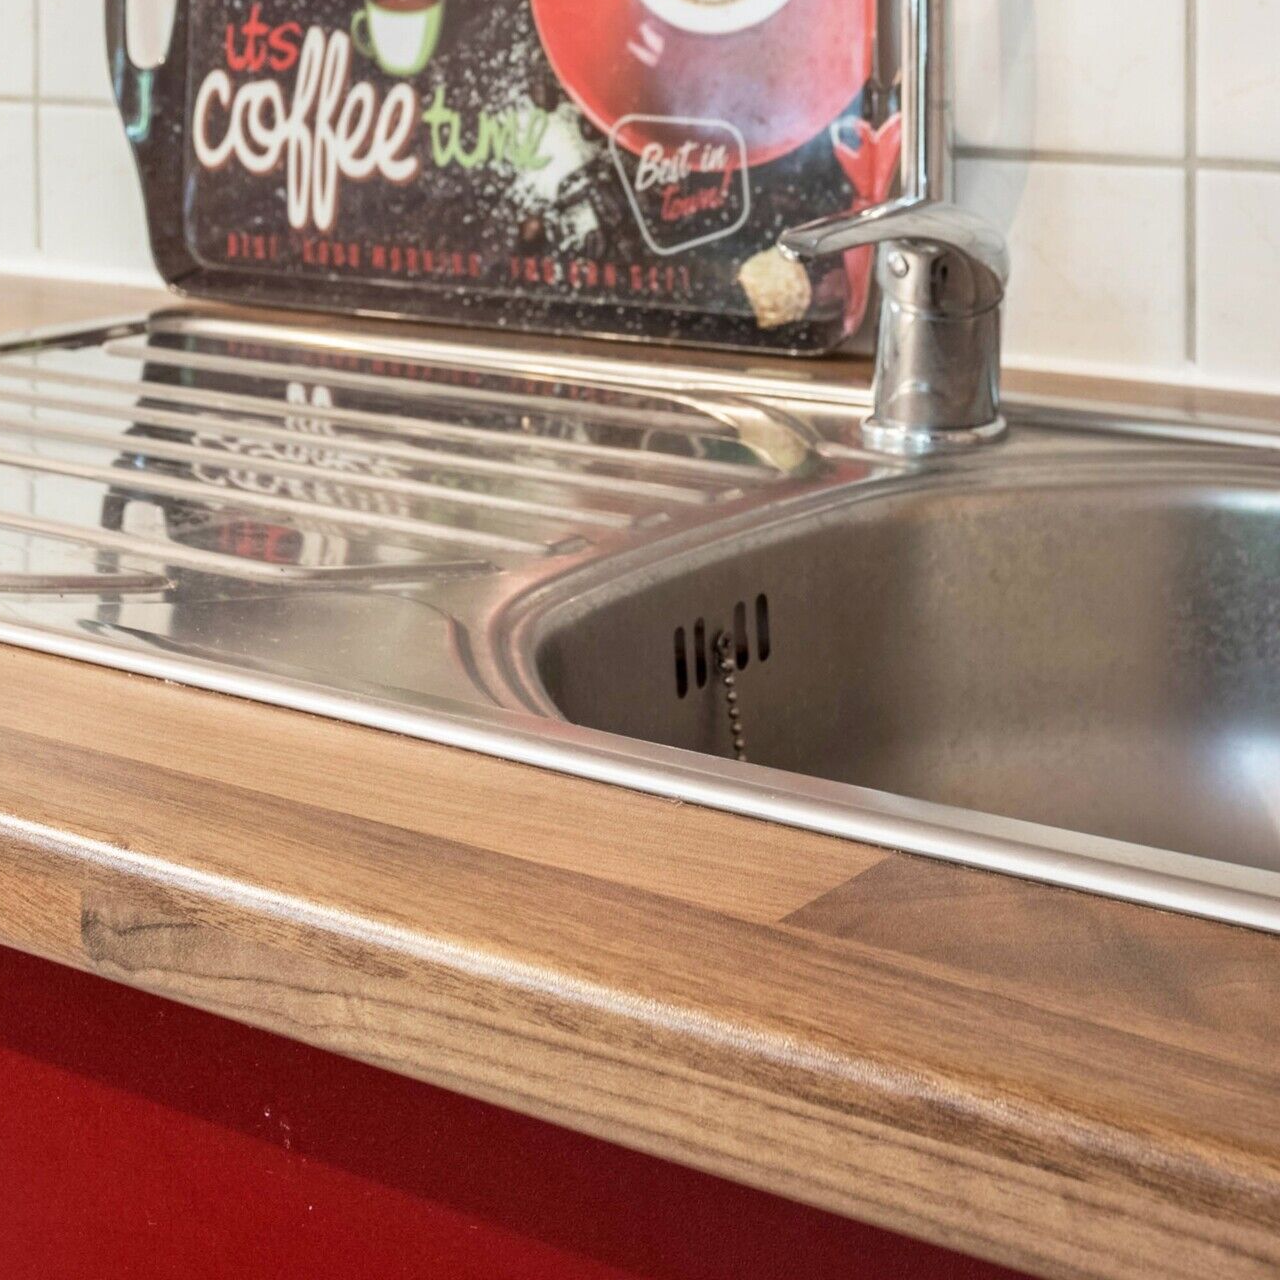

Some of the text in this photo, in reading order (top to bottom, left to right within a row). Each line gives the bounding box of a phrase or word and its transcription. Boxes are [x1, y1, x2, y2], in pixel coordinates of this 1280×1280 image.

[226, 1, 302, 71] its
[193, 25, 553, 231] coffee time
[634, 140, 728, 192] Best in
